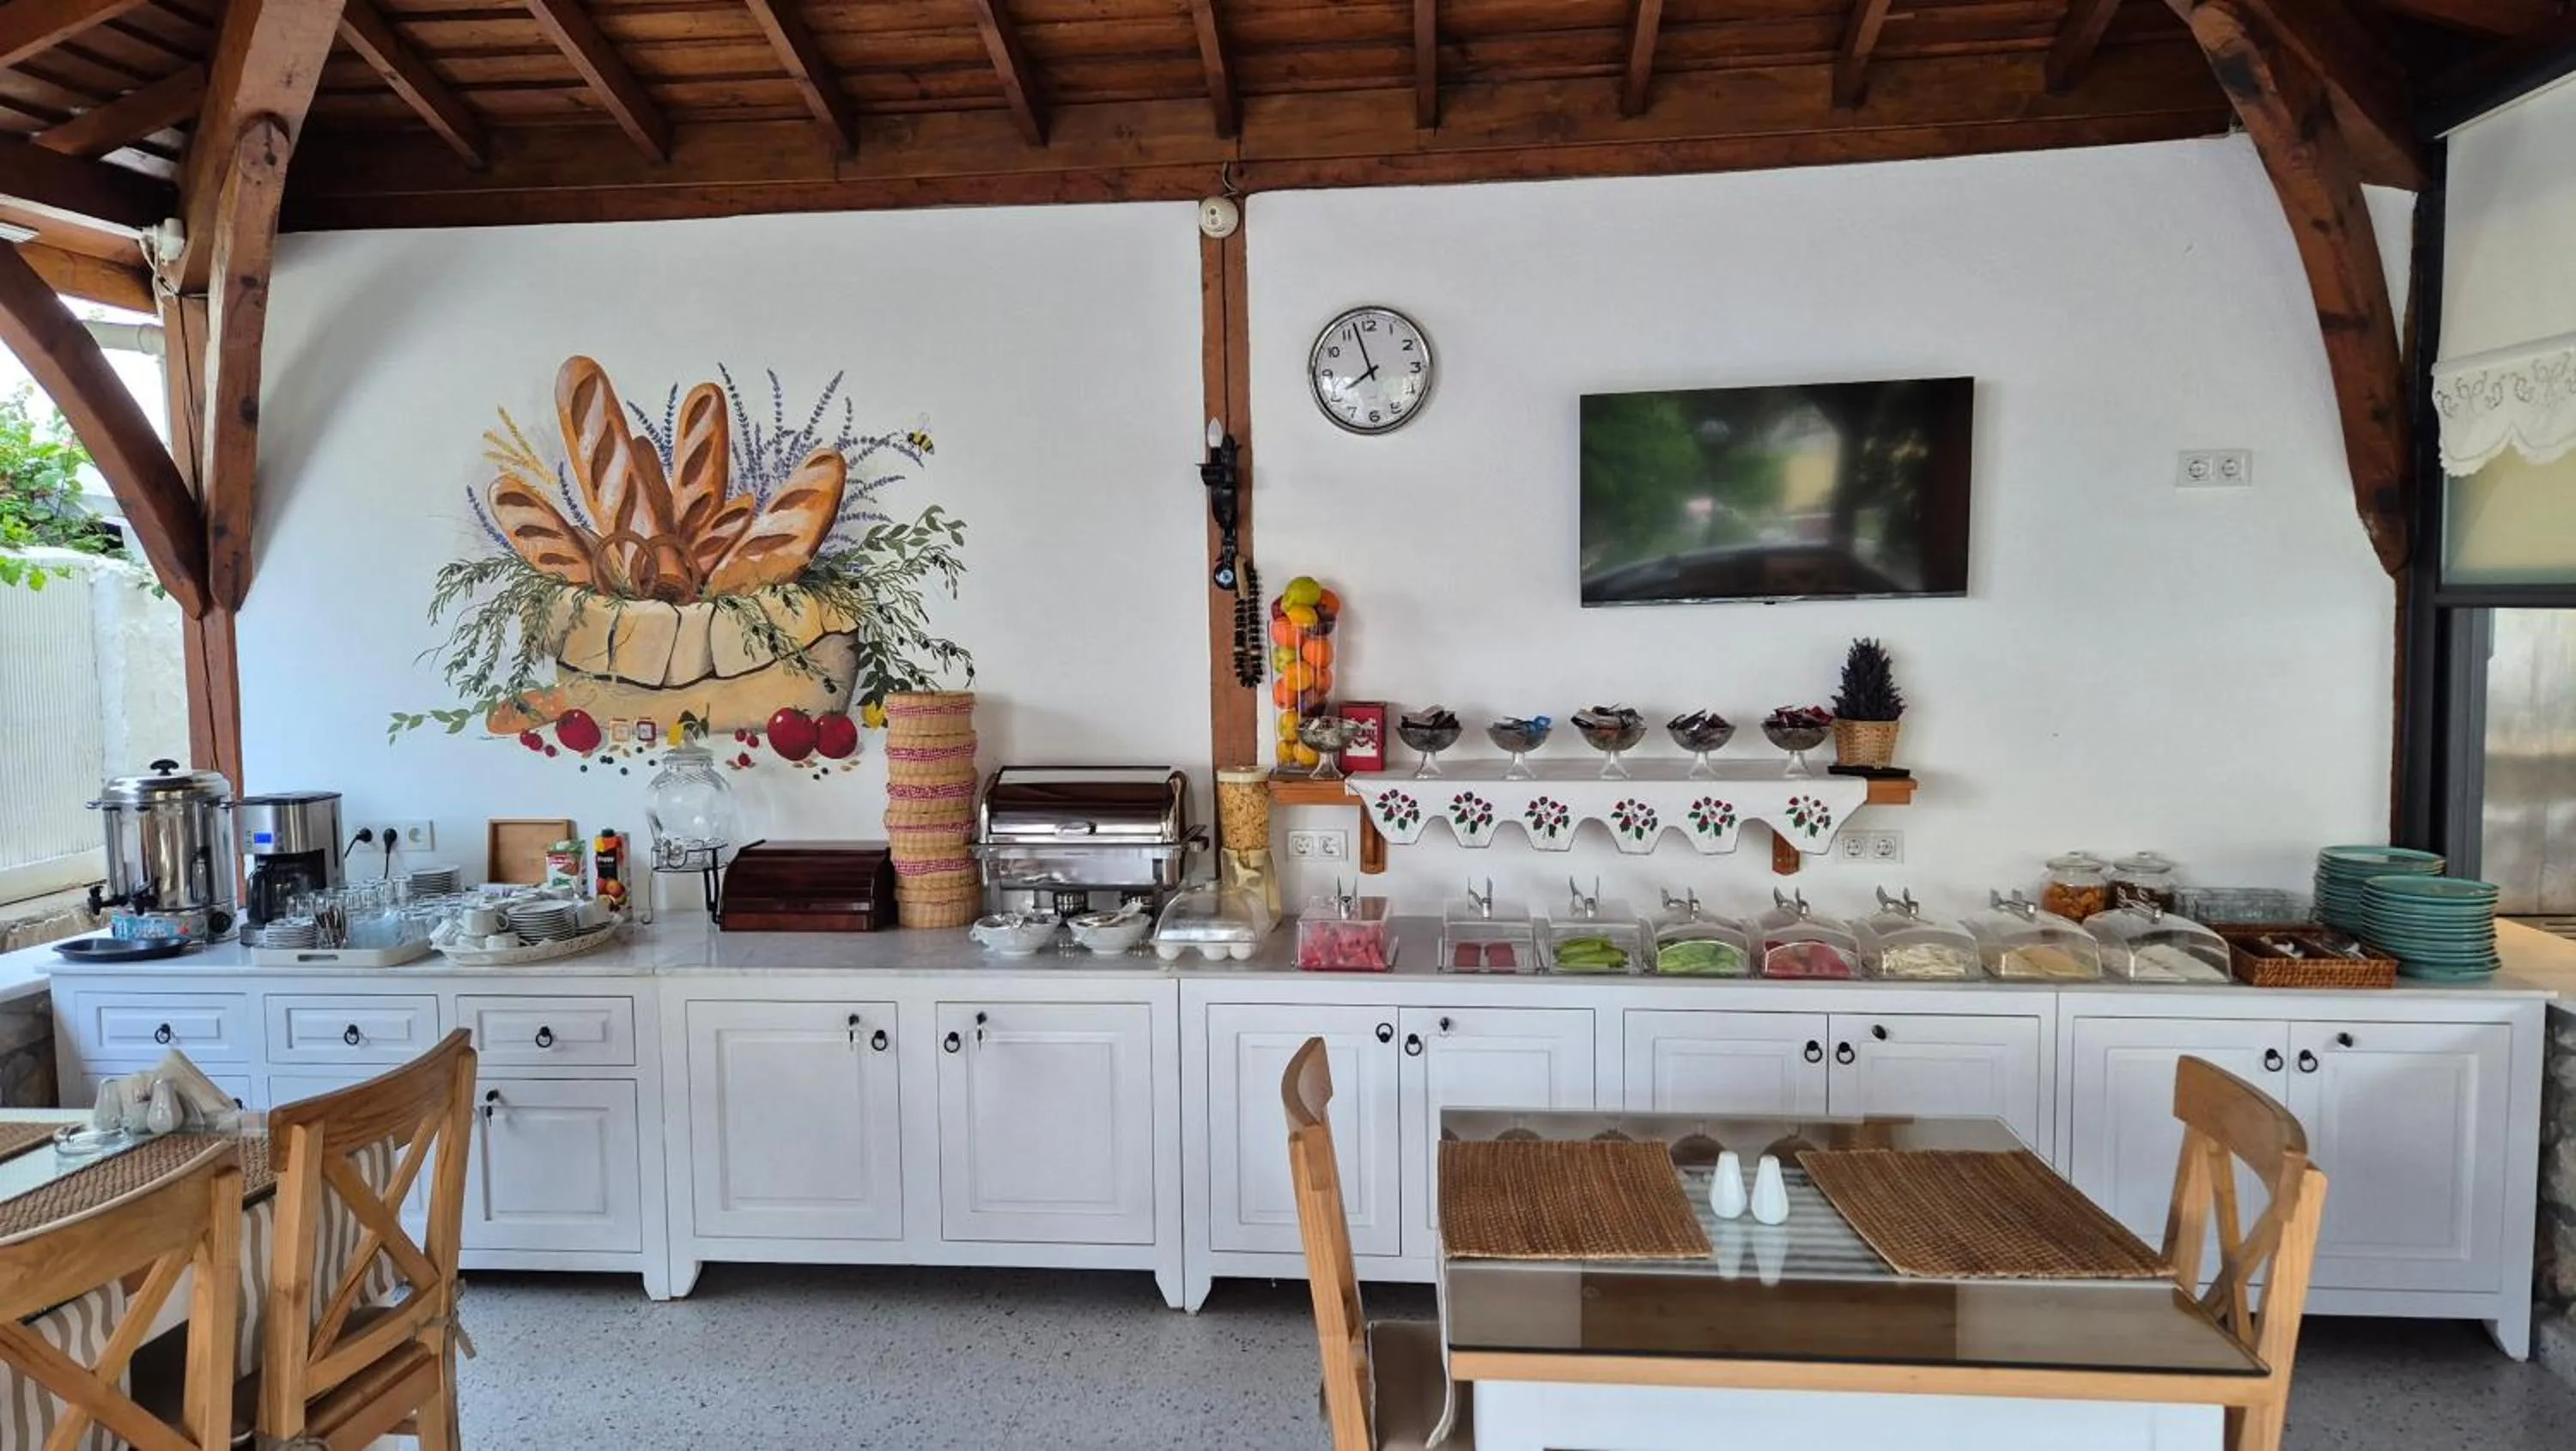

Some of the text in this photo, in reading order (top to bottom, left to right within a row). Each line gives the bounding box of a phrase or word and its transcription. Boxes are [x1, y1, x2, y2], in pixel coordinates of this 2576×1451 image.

[1362, 320, 1376, 331] 12
[1388, 323, 1393, 335] 1
[1342, 329, 1352, 341] 11
[1402, 339, 1414, 350] 2
[1327, 346, 1340, 357] 10
[1410, 361, 1422, 373] 3
[1347, 407, 1357, 418] 7
[1369, 410, 1381, 422] 6
